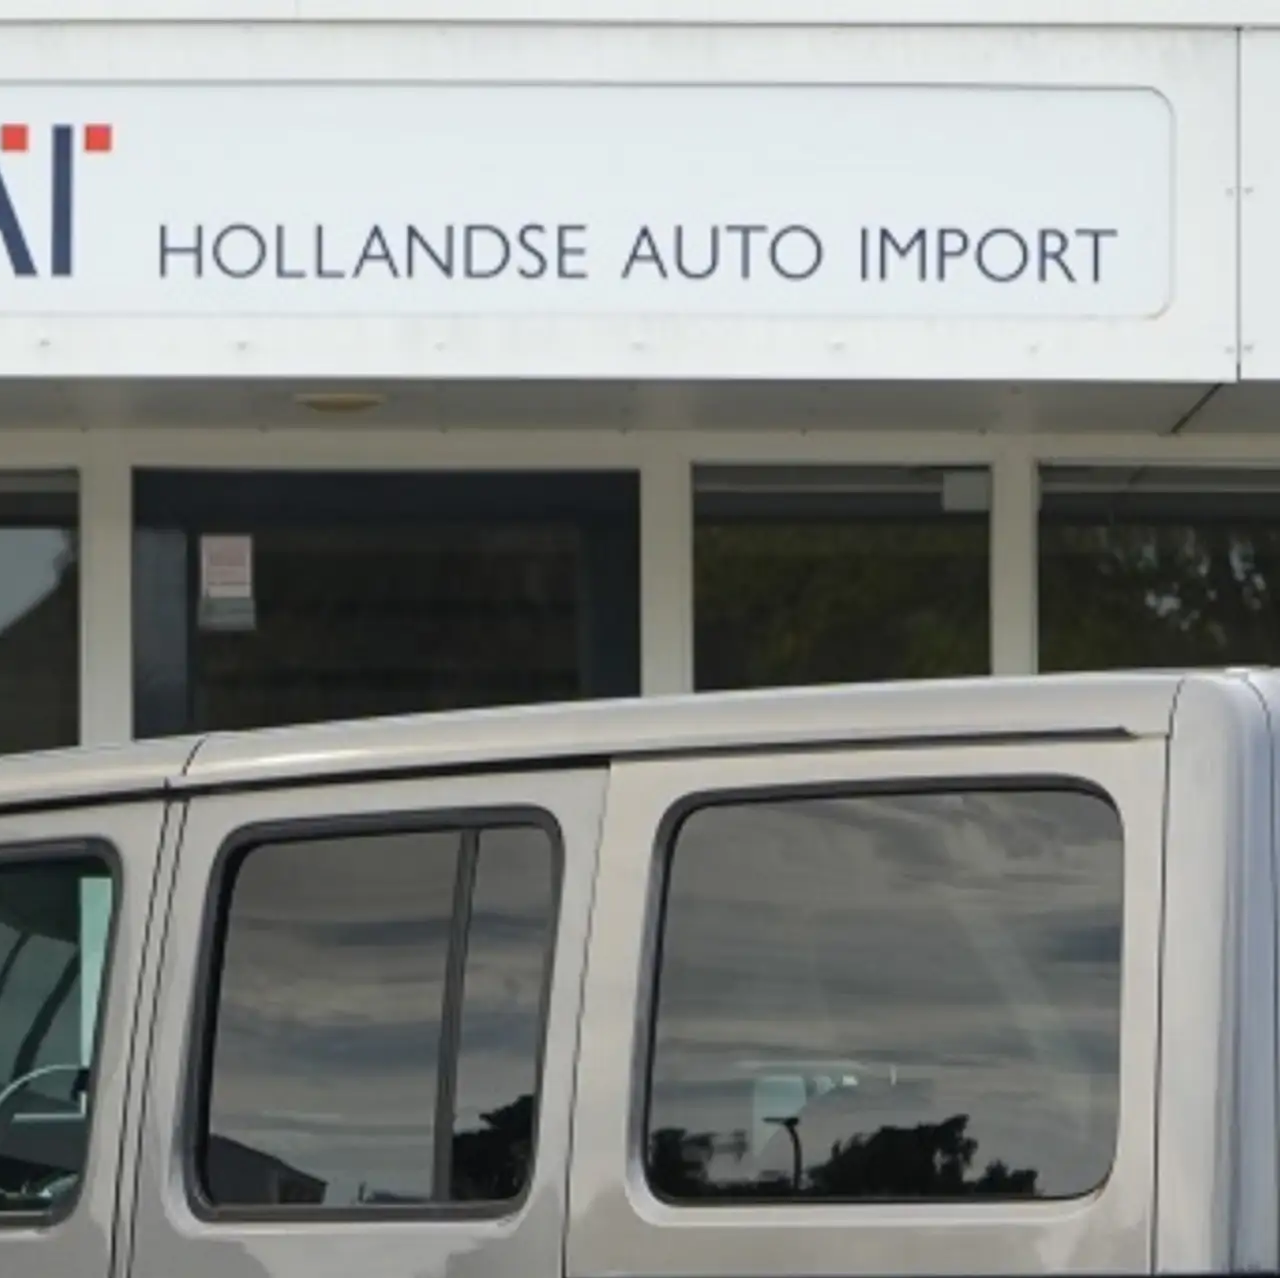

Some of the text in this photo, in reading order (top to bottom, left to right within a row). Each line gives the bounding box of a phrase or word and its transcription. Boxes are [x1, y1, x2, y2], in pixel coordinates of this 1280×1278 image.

[160, 224, 1116, 282] HOLLANDSE AUTO IMPORT
